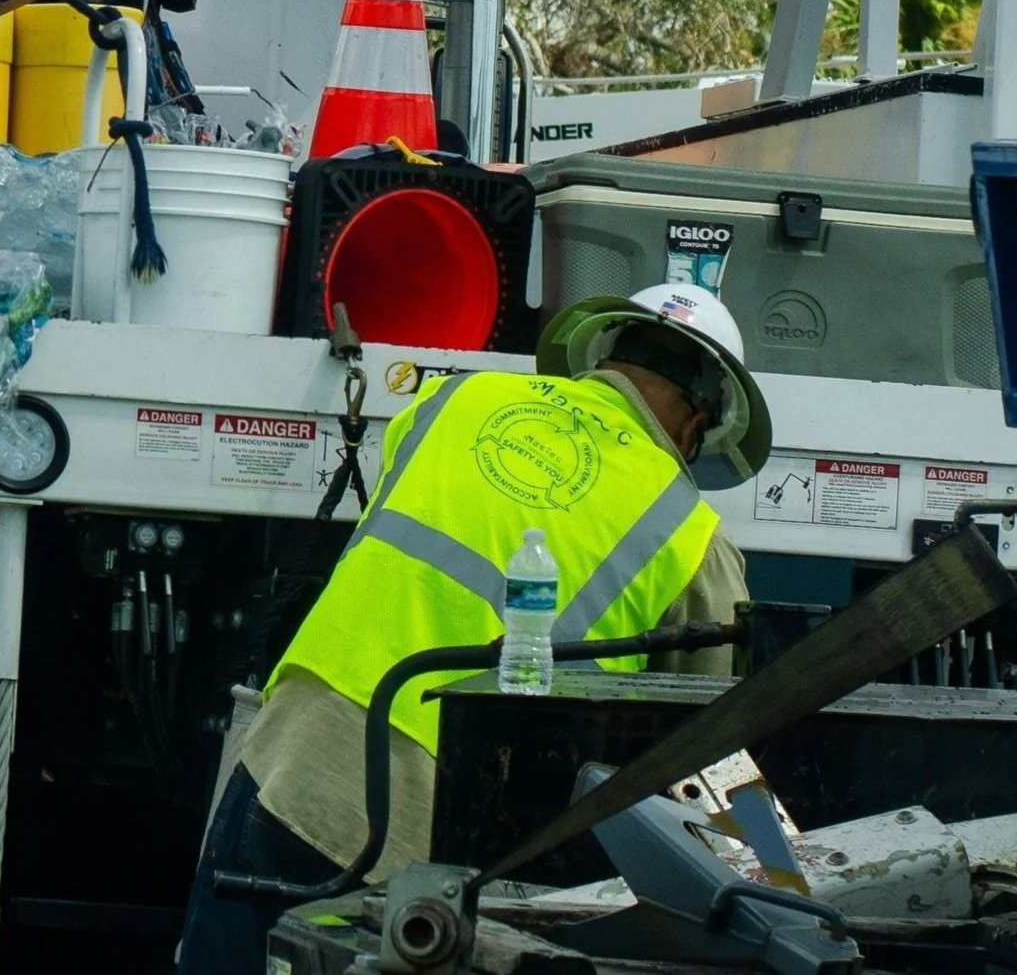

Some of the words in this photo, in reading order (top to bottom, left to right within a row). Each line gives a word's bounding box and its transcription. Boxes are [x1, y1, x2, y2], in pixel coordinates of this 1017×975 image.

[514, 122, 593, 143] NDER
[669, 225, 731, 242] IGLOO
[151, 411, 199, 425] DANGER
[490, 407, 552, 429] COMMITMENT
[236, 419, 311, 438] DANGER
[219, 437, 279, 447] ELECTROCUTION
[279, 441, 310, 449] HAZARD
[502, 439, 535, 461] SAFETY
[544, 466, 563, 481] YOU
[841, 463, 885, 475] DANGER
[938, 470, 984, 483] DANGER
